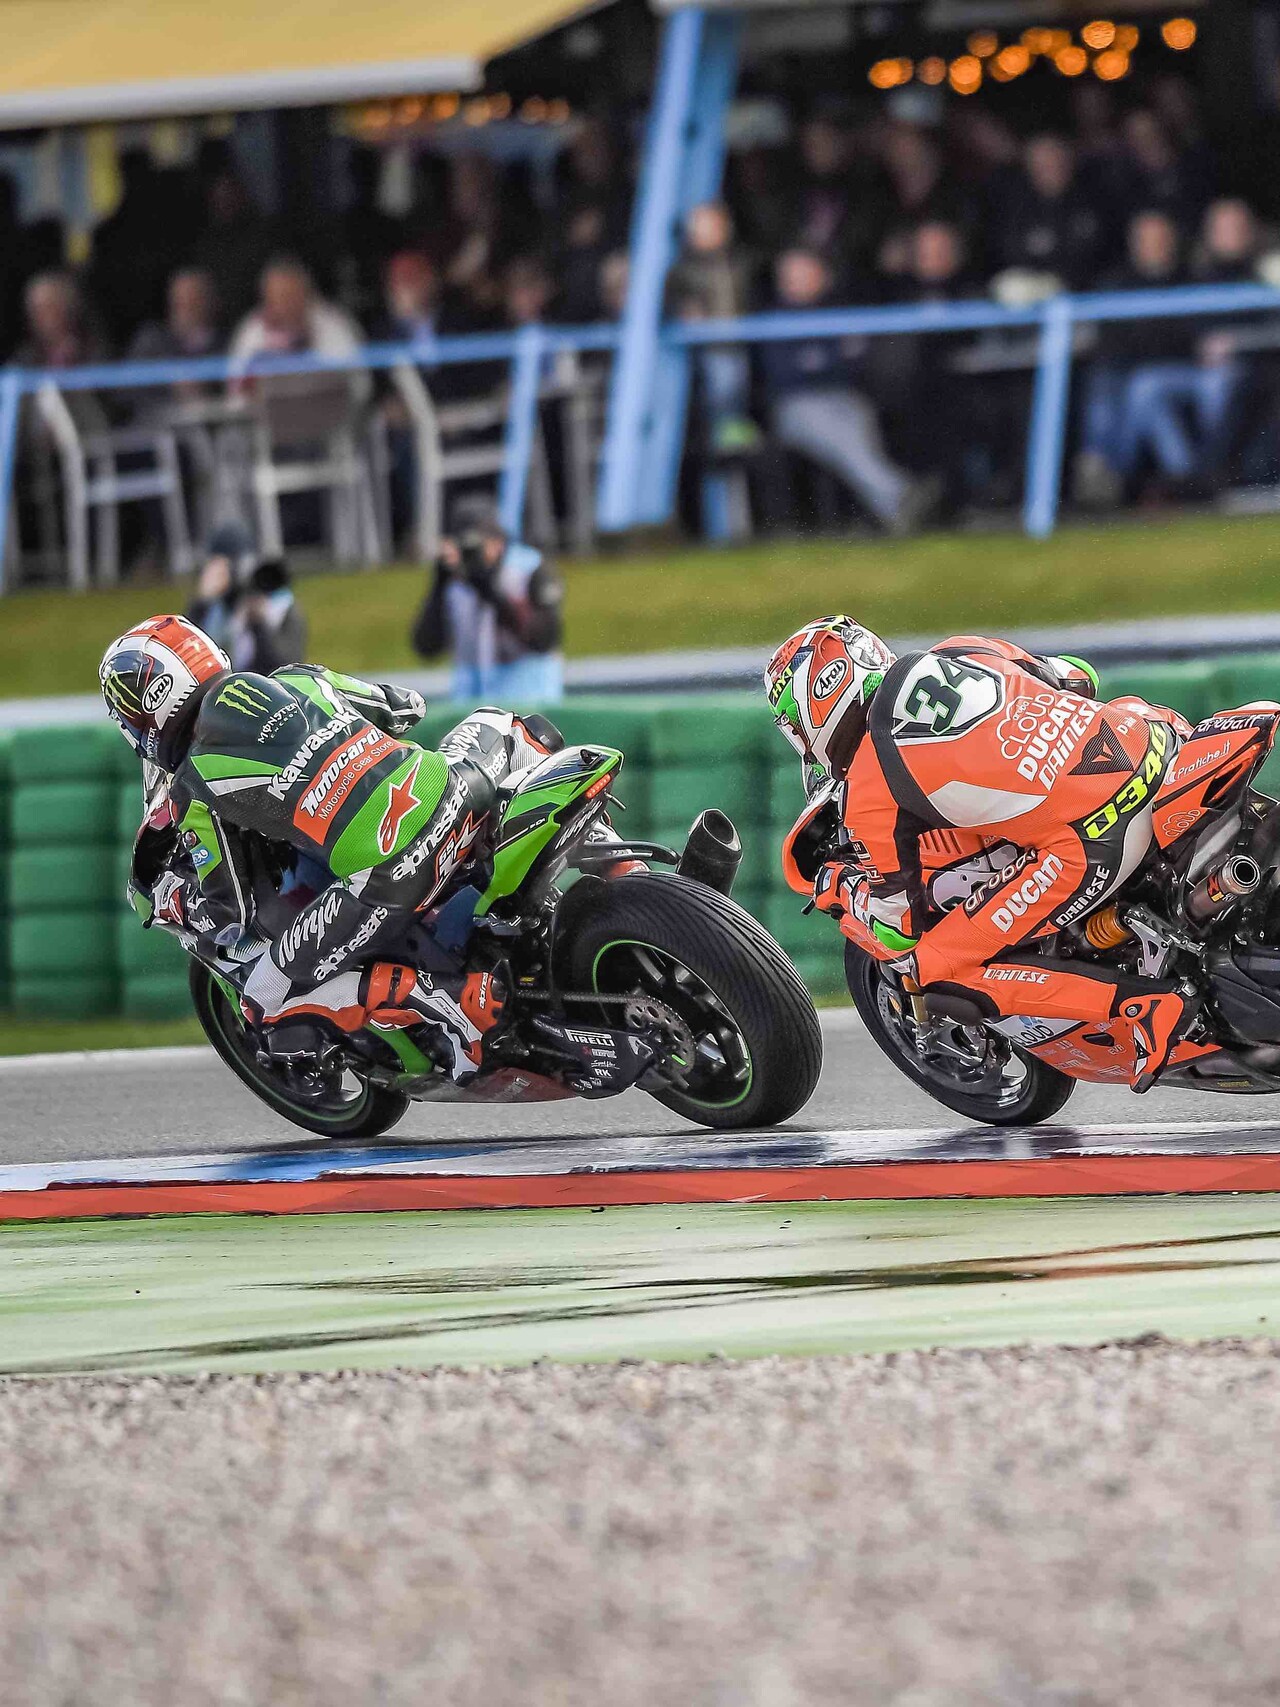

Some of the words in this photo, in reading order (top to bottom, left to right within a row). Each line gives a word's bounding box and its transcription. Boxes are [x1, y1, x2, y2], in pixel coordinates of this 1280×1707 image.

[146, 676, 171, 710] Arai
[818, 661, 845, 697] Arai
[904, 657, 987, 735] 34
[1001, 693, 1055, 760] CLOUD
[318, 771, 355, 820] Motorcycle
[352, 755, 374, 773] Gear
[371, 739, 394, 758] Store
[391, 776, 469, 881] alpinestars
[1164, 809, 1201, 839] CLOUD
[990, 853, 1064, 933] DUCATI
[278, 892, 343, 968] Ninja
[313, 906, 389, 981] alpinestars
[983, 968, 1052, 984] DAINESE
[564, 1028, 615, 1047] PIRELLI
[594, 1068, 611, 1077] RK
